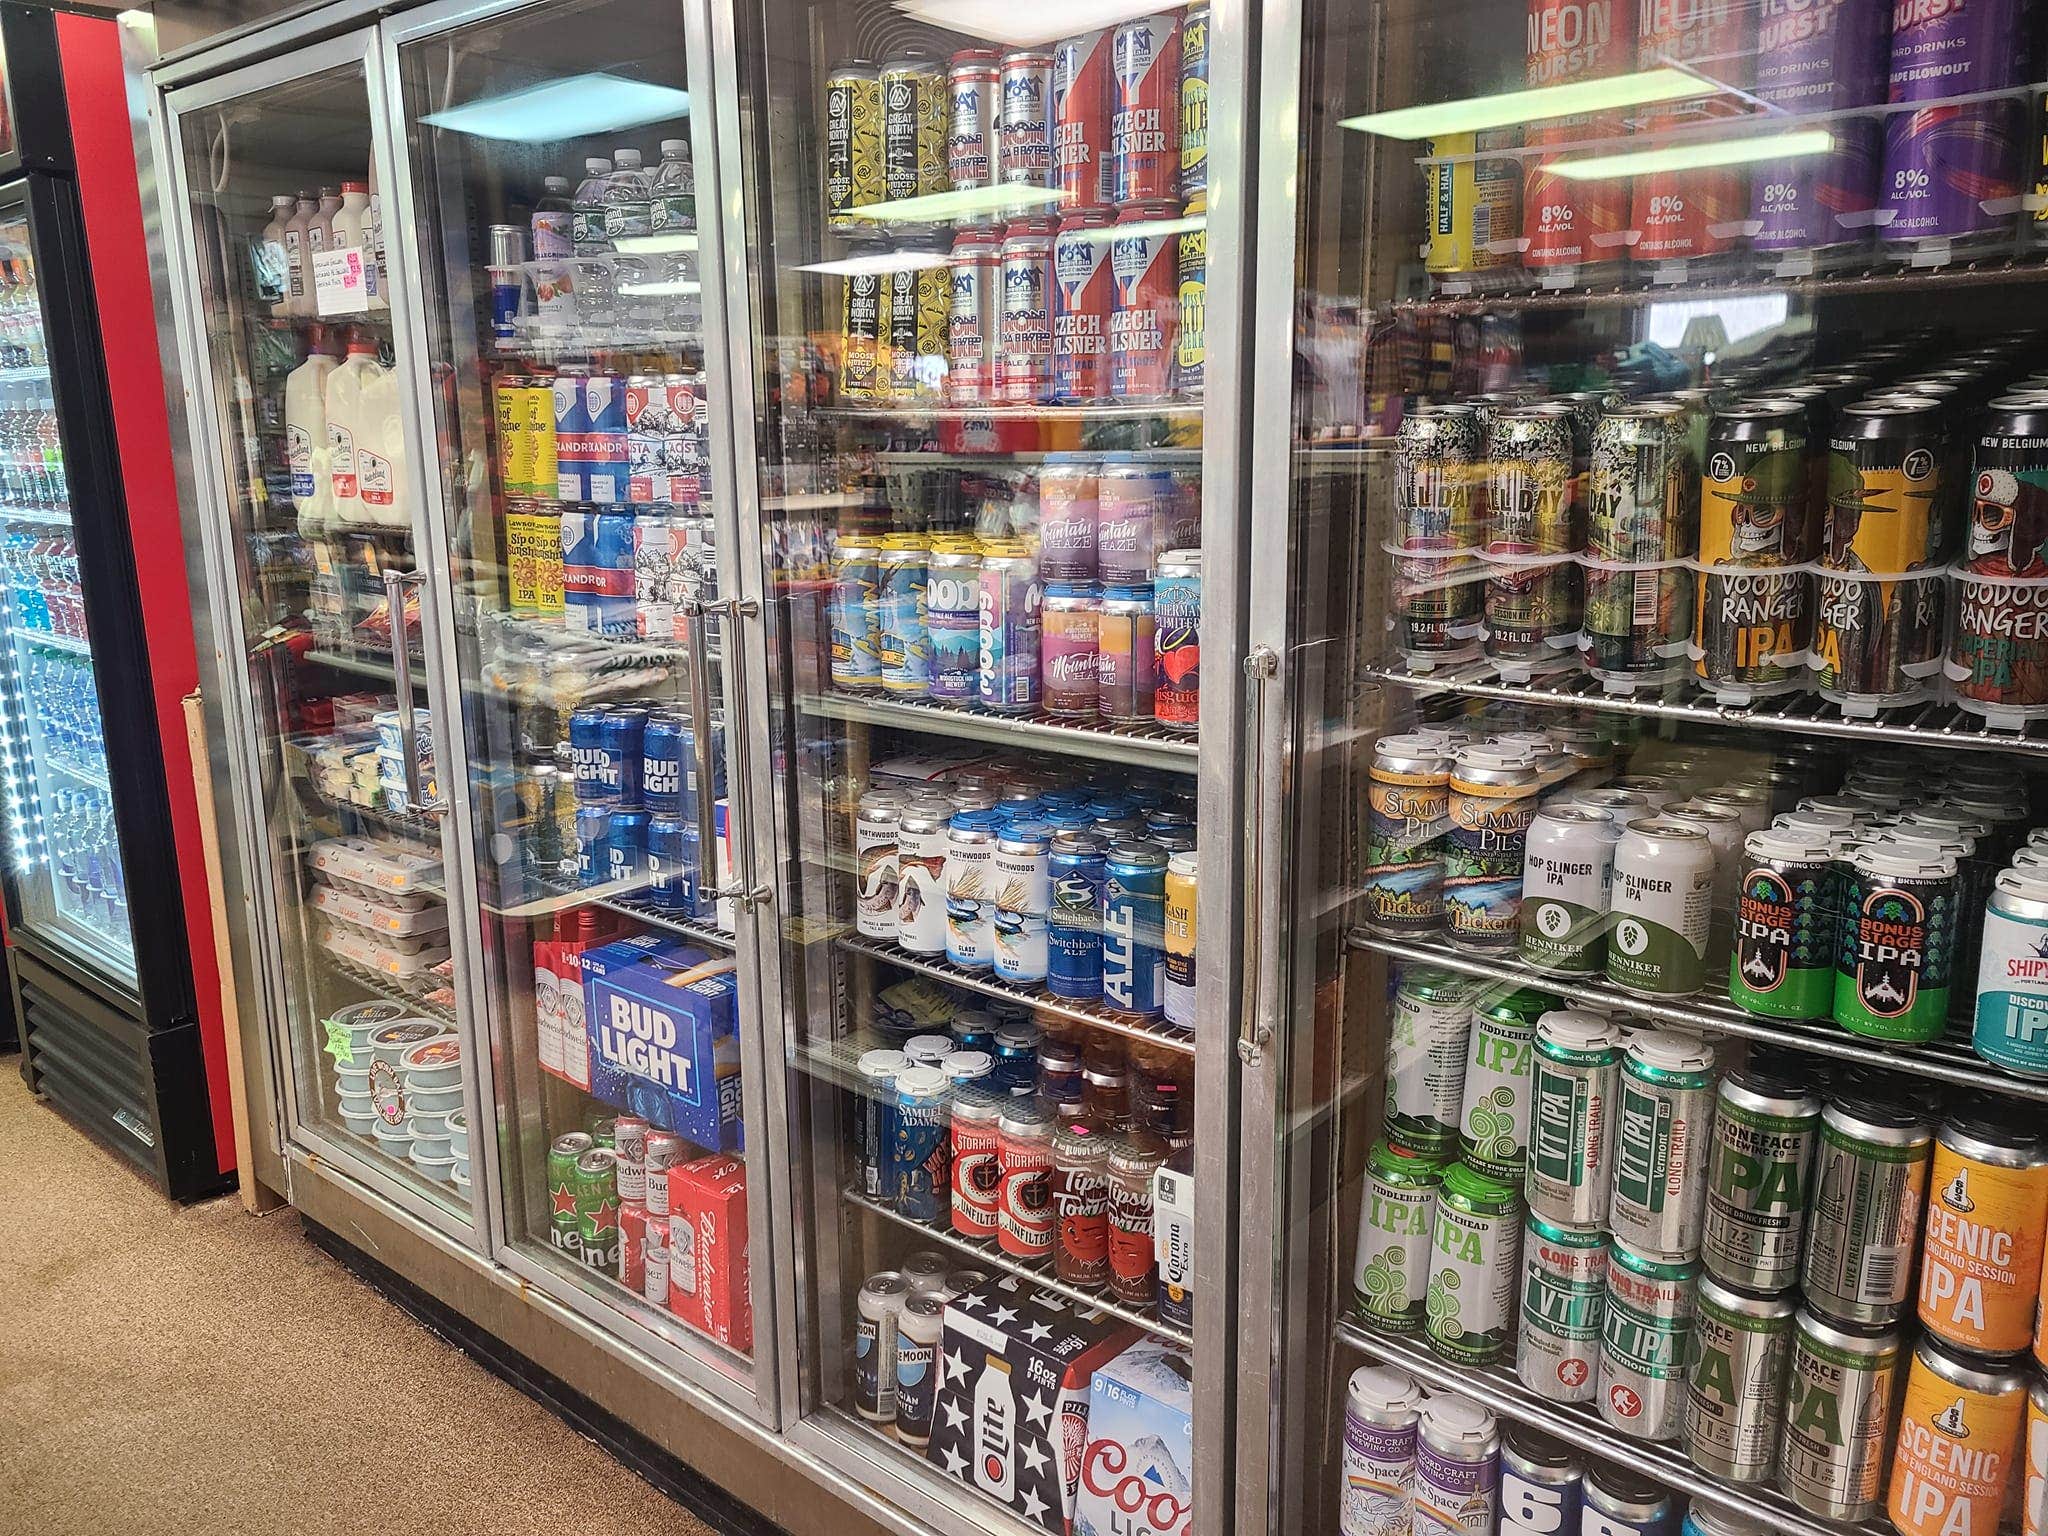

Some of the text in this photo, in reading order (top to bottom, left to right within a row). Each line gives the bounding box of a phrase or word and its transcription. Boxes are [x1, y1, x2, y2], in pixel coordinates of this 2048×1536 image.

[1527, 2, 1612, 54] NEON
[1914, 36, 1967, 54] DRINKS
[1527, 44, 1599, 88] BURST
[1780, 58, 1830, 75] DRINKS
[1909, 61, 1972, 81] BLOWOUT
[828, 119, 848, 130] GREAT
[888, 113, 912, 124] GREAT
[1111, 108, 1161, 135] CZECH
[828, 130, 849, 141] NORTH
[887, 123, 914, 135] NORTH
[829, 177, 850, 185] MOOSE
[887, 173, 916, 181] MOOSE
[889, 181, 912, 190] JUICE
[1002, 173, 1046, 182] PALE ALE
[1895, 168, 1930, 189] 8%
[829, 184, 847, 193] JUICE
[892, 188, 907, 198] IPA
[1764, 183, 1798, 203] 8%
[1541, 204, 1574, 224] 8%
[1649, 195, 1683, 216] 8%
[1439, 207, 1450, 233] HALF
[1909, 216, 1940, 229] ALCOHOL
[1776, 227, 1807, 240] ALCOHOL
[1554, 246, 1583, 258] ALCOHOL
[1663, 239, 1693, 250] ALCOHOL
[851, 298, 874, 309] GREAT
[893, 295, 914, 307] GREAT
[850, 308, 876, 319] NORTH
[892, 306, 914, 316] NORTH
[1054, 314, 1101, 335] CZECH
[1110, 309, 1157, 333] CZECH
[848, 351, 875, 360] MOOSE
[1003, 359, 1046, 367] PALE ALE
[1745, 438, 1807, 453] NEW BELGIUM
[1981, 436, 2048, 449] NEW BELGIUM
[1518, 486, 1564, 512] DAY
[510, 533, 527, 547] Sip
[549, 535, 562, 548] of
[1050, 535, 1092, 549] HAZE
[1100, 537, 1137, 551] HAZE
[518, 589, 536, 600] IPA
[541, 593, 557, 604] IPA
[1411, 601, 1439, 613] SESSION
[1411, 621, 1427, 633] 19.2
[1494, 628, 1510, 641] 19.2
[1736, 626, 1794, 668] IPA
[1971, 657, 2013, 687] IPA
[643, 757, 680, 777] BUD
[858, 828, 899, 838] NORTHWOODS
[1404, 816, 1443, 838] PILS
[1480, 828, 1523, 850] PILS
[949, 848, 991, 860] NORTHWOODS
[1769, 858, 1809, 869] BREWING
[1528, 853, 1544, 869] HOP
[1546, 860, 1593, 876] SLINGER
[1546, 872, 1564, 886] IPA
[1625, 874, 1672, 893] SLINGER
[1870, 871, 1896, 884] CREEK
[1625, 887, 1641, 901] IPA
[1052, 909, 1099, 922] Switchback
[1741, 897, 1792, 918] BONUS
[1740, 907, 1792, 929] STAGE
[1739, 918, 1790, 946] IPA
[1860, 918, 1924, 938] BONUS
[623, 938, 657, 949] LIGHT
[635, 934, 662, 944] BUD
[1049, 931, 1104, 949] Switchback
[1525, 935, 1583, 953] HENNIKER
[1859, 929, 1923, 949] STAGE
[957, 944, 976, 954] GLASS
[1103, 899, 1133, 1009] ALE
[1549, 948, 1583, 958] COMPANY
[1858, 940, 1921, 967] IPA
[582, 958, 591, 970] 12
[1001, 957, 1020, 967] GLASS
[1627, 967, 1661, 979] COMPANY
[686, 983, 722, 998] LIGHT
[699, 978, 728, 992] BUD
[610, 993, 677, 1050] BUD
[600, 1024, 692, 1093] LIGHT
[718, 1076, 737, 1126] LIGHT
[899, 1103, 944, 1117] SAMUEL
[1540, 1090, 1571, 1125] IPA
[901, 1115, 941, 1127] ADAMS
[1623, 1109, 1652, 1150] IPA
[1573, 1111, 1587, 1155] Vermont
[1586, 1099, 1601, 1164] LONG TRAIL
[1716, 1114, 1800, 1150] STONEFACE
[1538, 1126, 1569, 1161] VT
[1724, 1133, 1770, 1157] BREWING
[1467, 1154, 1508, 1171] PLEASE STORE
[1619, 1146, 1649, 1184] VT
[1653, 1132, 1669, 1180] Vermont
[1668, 1123, 1687, 1191] LONG TRAIL
[1372, 1183, 1432, 1203] FIDDLEHEAD
[1858, 1171, 1871, 1203] CRAFT
[1368, 1194, 1429, 1236] IPA
[1733, 1209, 1783, 1227] DRINK FRESH
[1433, 1213, 1485, 1265] IPA
[1167, 1223, 1183, 1283] Corona
[1180, 1242, 1189, 1272] Extra
[1927, 1239, 2017, 1286] ENGLAND SESSION
[699, 1210, 717, 1331] Budweiser
[1608, 1268, 1676, 1301] LONG TRAIL
[1921, 1253, 1985, 1331] IPA
[1540, 1285, 1574, 1323] VT
[718, 1322, 729, 1343] 12
[1550, 1324, 1595, 1340] Vermont
[1631, 1328, 1674, 1365] IPA
[904, 1351, 932, 1363] MOON
[1608, 1345, 1652, 1376] Vermont
[1028, 1356, 1058, 1384] 16oz
[1694, 1346, 1738, 1408] A
[1032, 1373, 1057, 1391] PINTS
[1094, 1379, 1120, 1401] 9 16
[1119, 1396, 1137, 1409] PINTS
[1795, 1385, 1845, 1447] A
[982, 1397, 1011, 1458] Lite
[1351, 1433, 1386, 1453] BREWING
[1384, 1435, 1415, 1447] CRAFT
[1902, 1416, 2000, 1484] SCENIC
[1347, 1450, 1400, 1479] Safe Space
[1444, 1467, 1477, 1480] CRAFT
[1909, 1457, 1957, 1489] ENGLAND
[1427, 1487, 1460, 1511] Space
